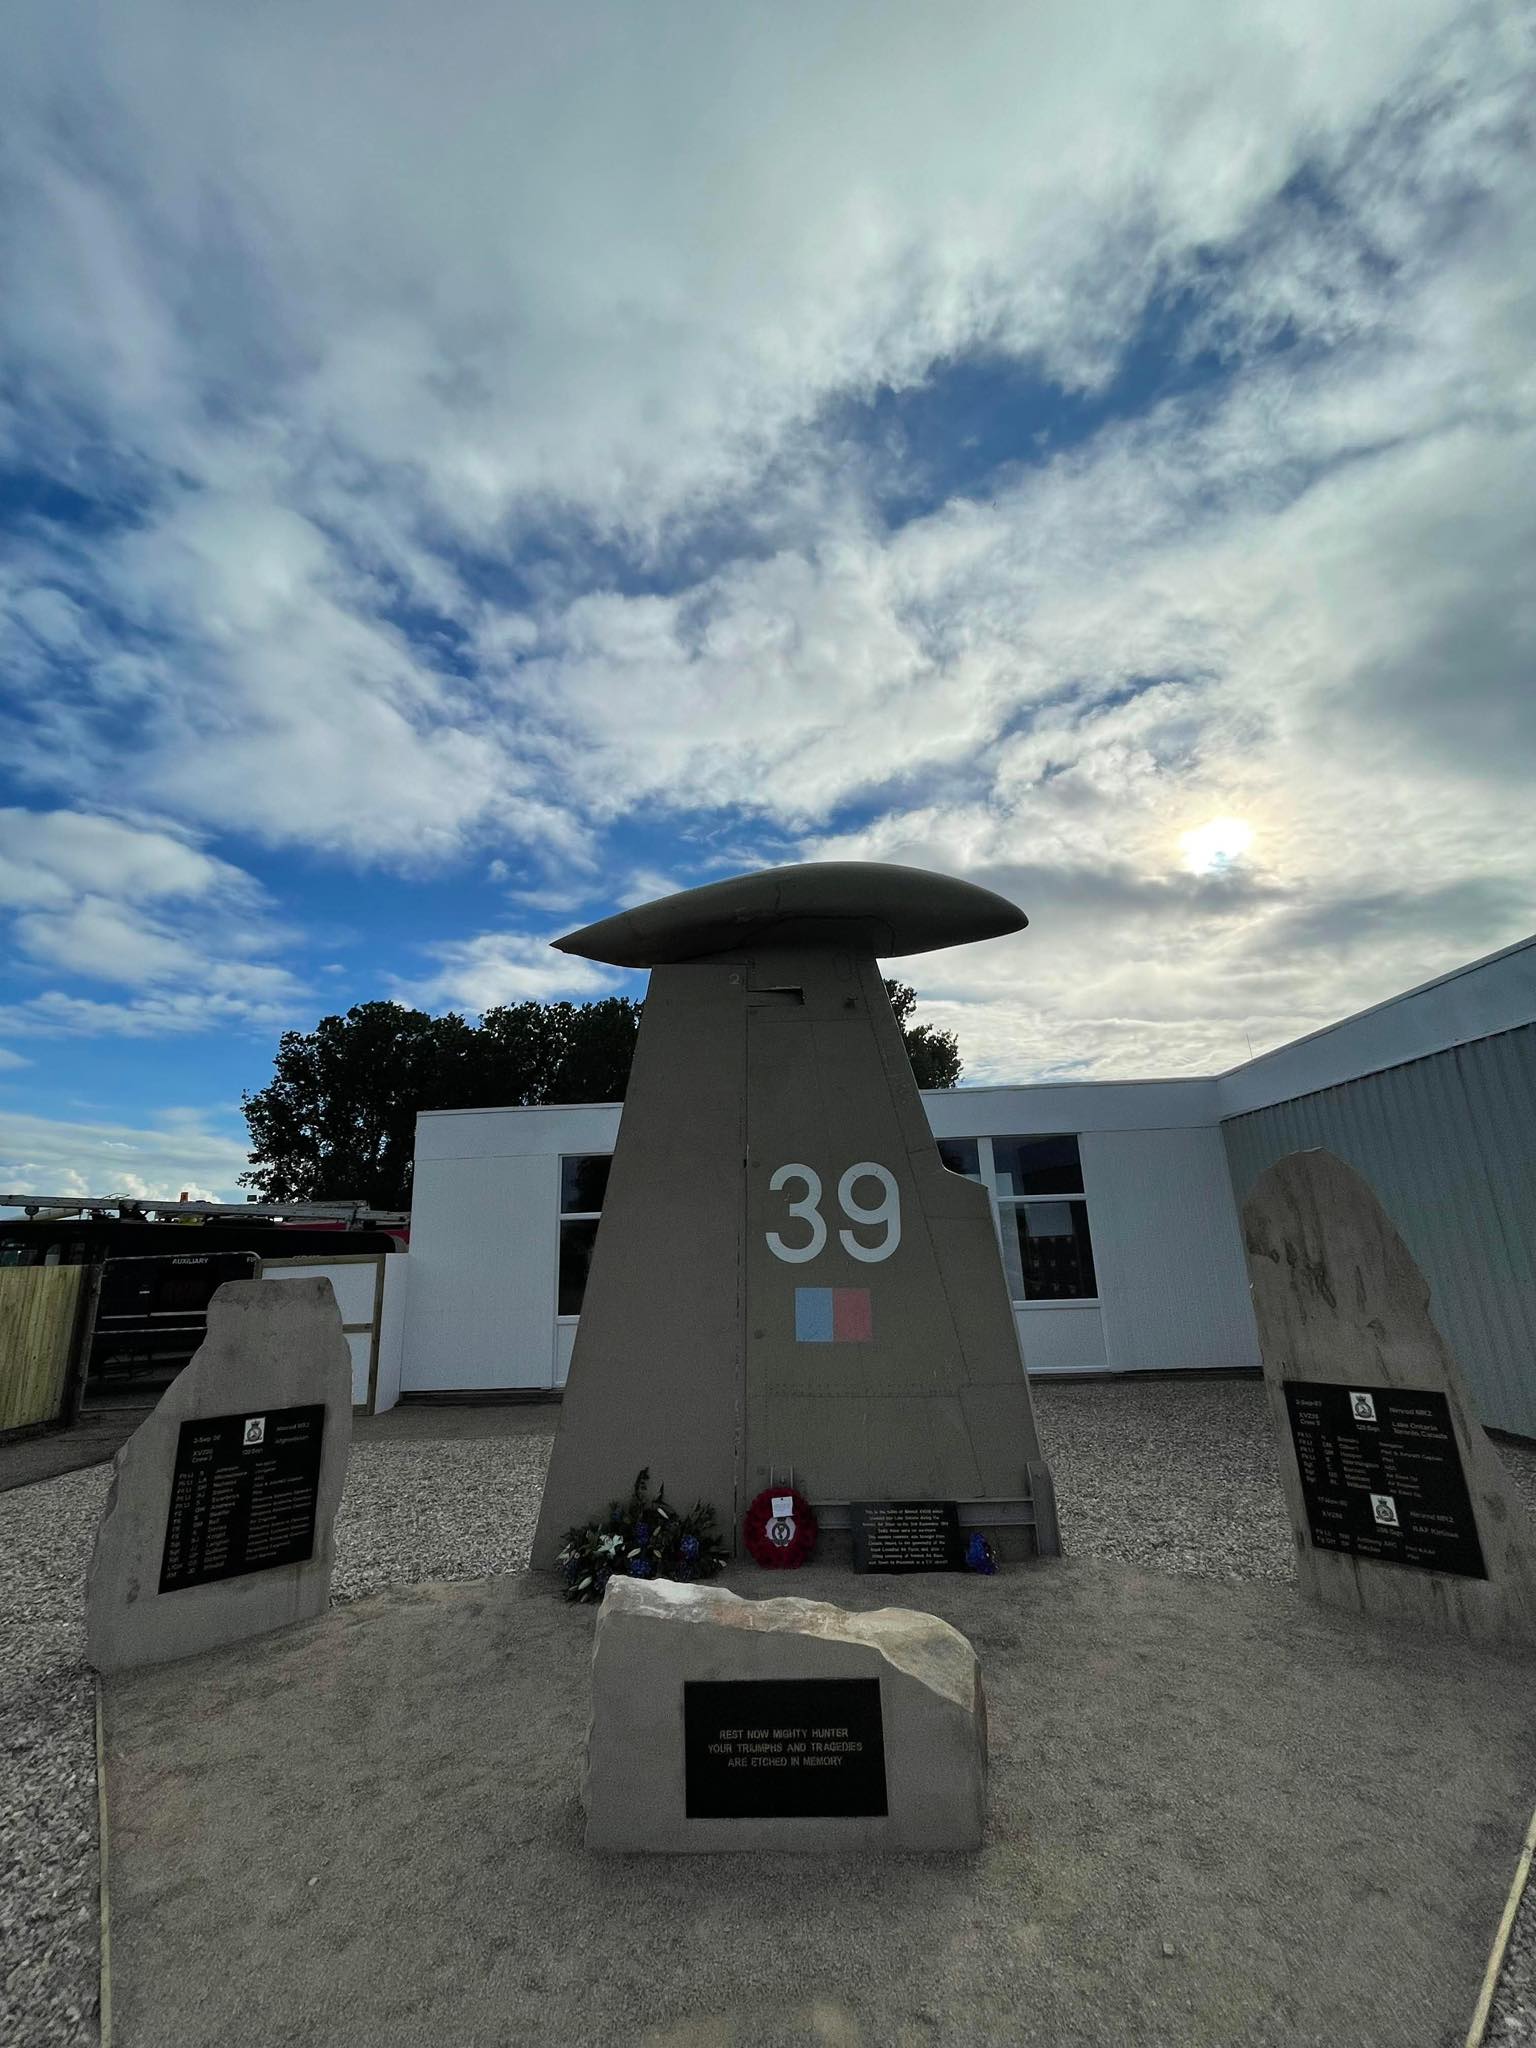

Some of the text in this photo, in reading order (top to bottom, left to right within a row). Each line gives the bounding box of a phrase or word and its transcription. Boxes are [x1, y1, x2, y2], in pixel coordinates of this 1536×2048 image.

[765, 1161, 901, 1263] 39
[172, 1257, 209, 1265] AUXILIARY
[719, 1728, 849, 1740] REST NOW MIGHTY HUNTER
[708, 1741, 863, 1753] YOUR TRIUMPHS AND TRAGEDIES
[728, 1755, 843, 1767] ARE ETCHED IN MEMORY
